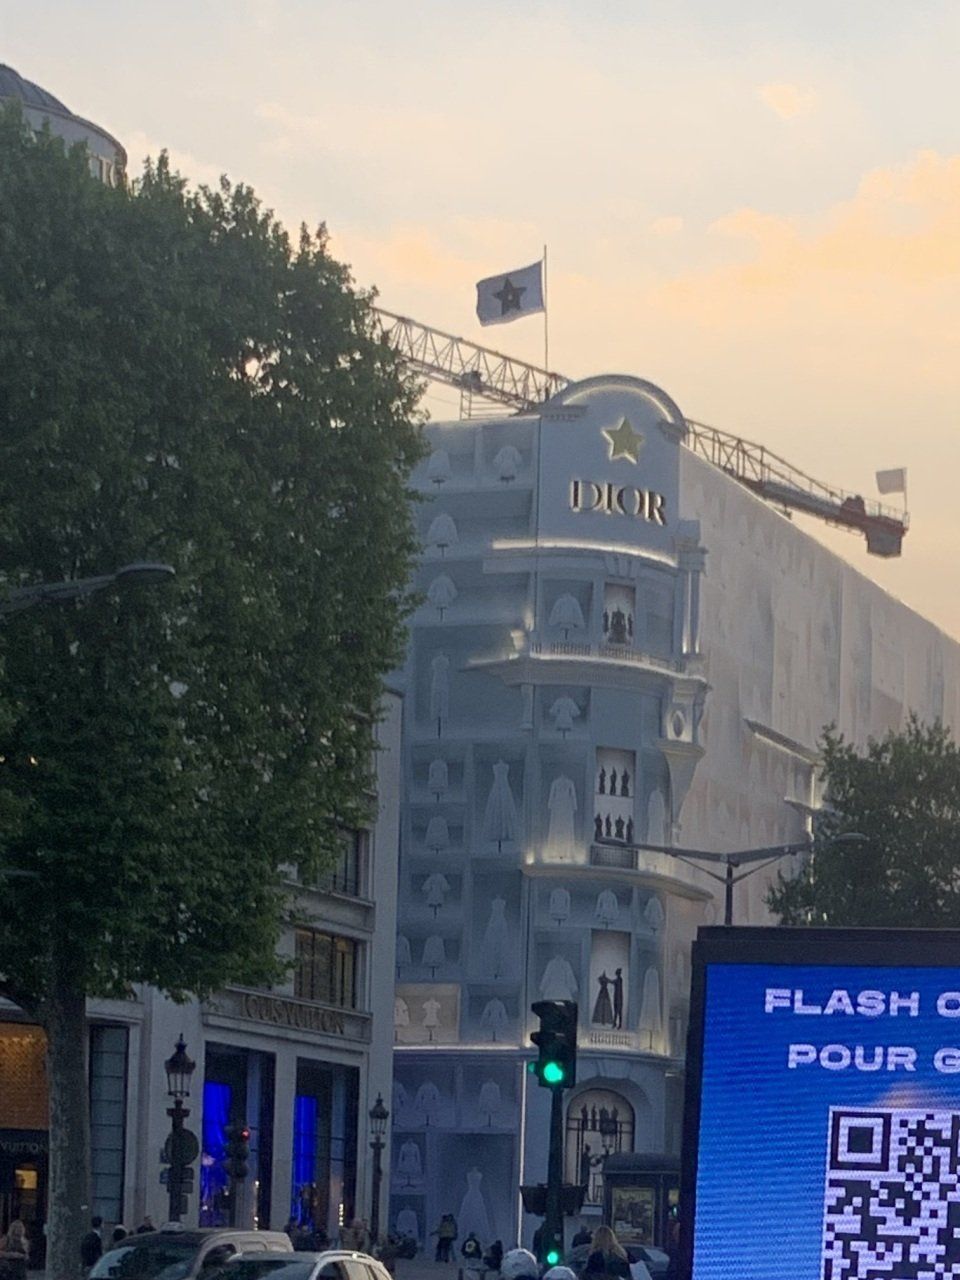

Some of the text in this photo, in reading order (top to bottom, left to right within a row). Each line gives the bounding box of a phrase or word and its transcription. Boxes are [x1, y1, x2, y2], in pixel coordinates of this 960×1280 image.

[570, 480, 666, 527] DIOR
[765, 987, 920, 1017] FLASH
[788, 1043, 918, 1072] POUR
